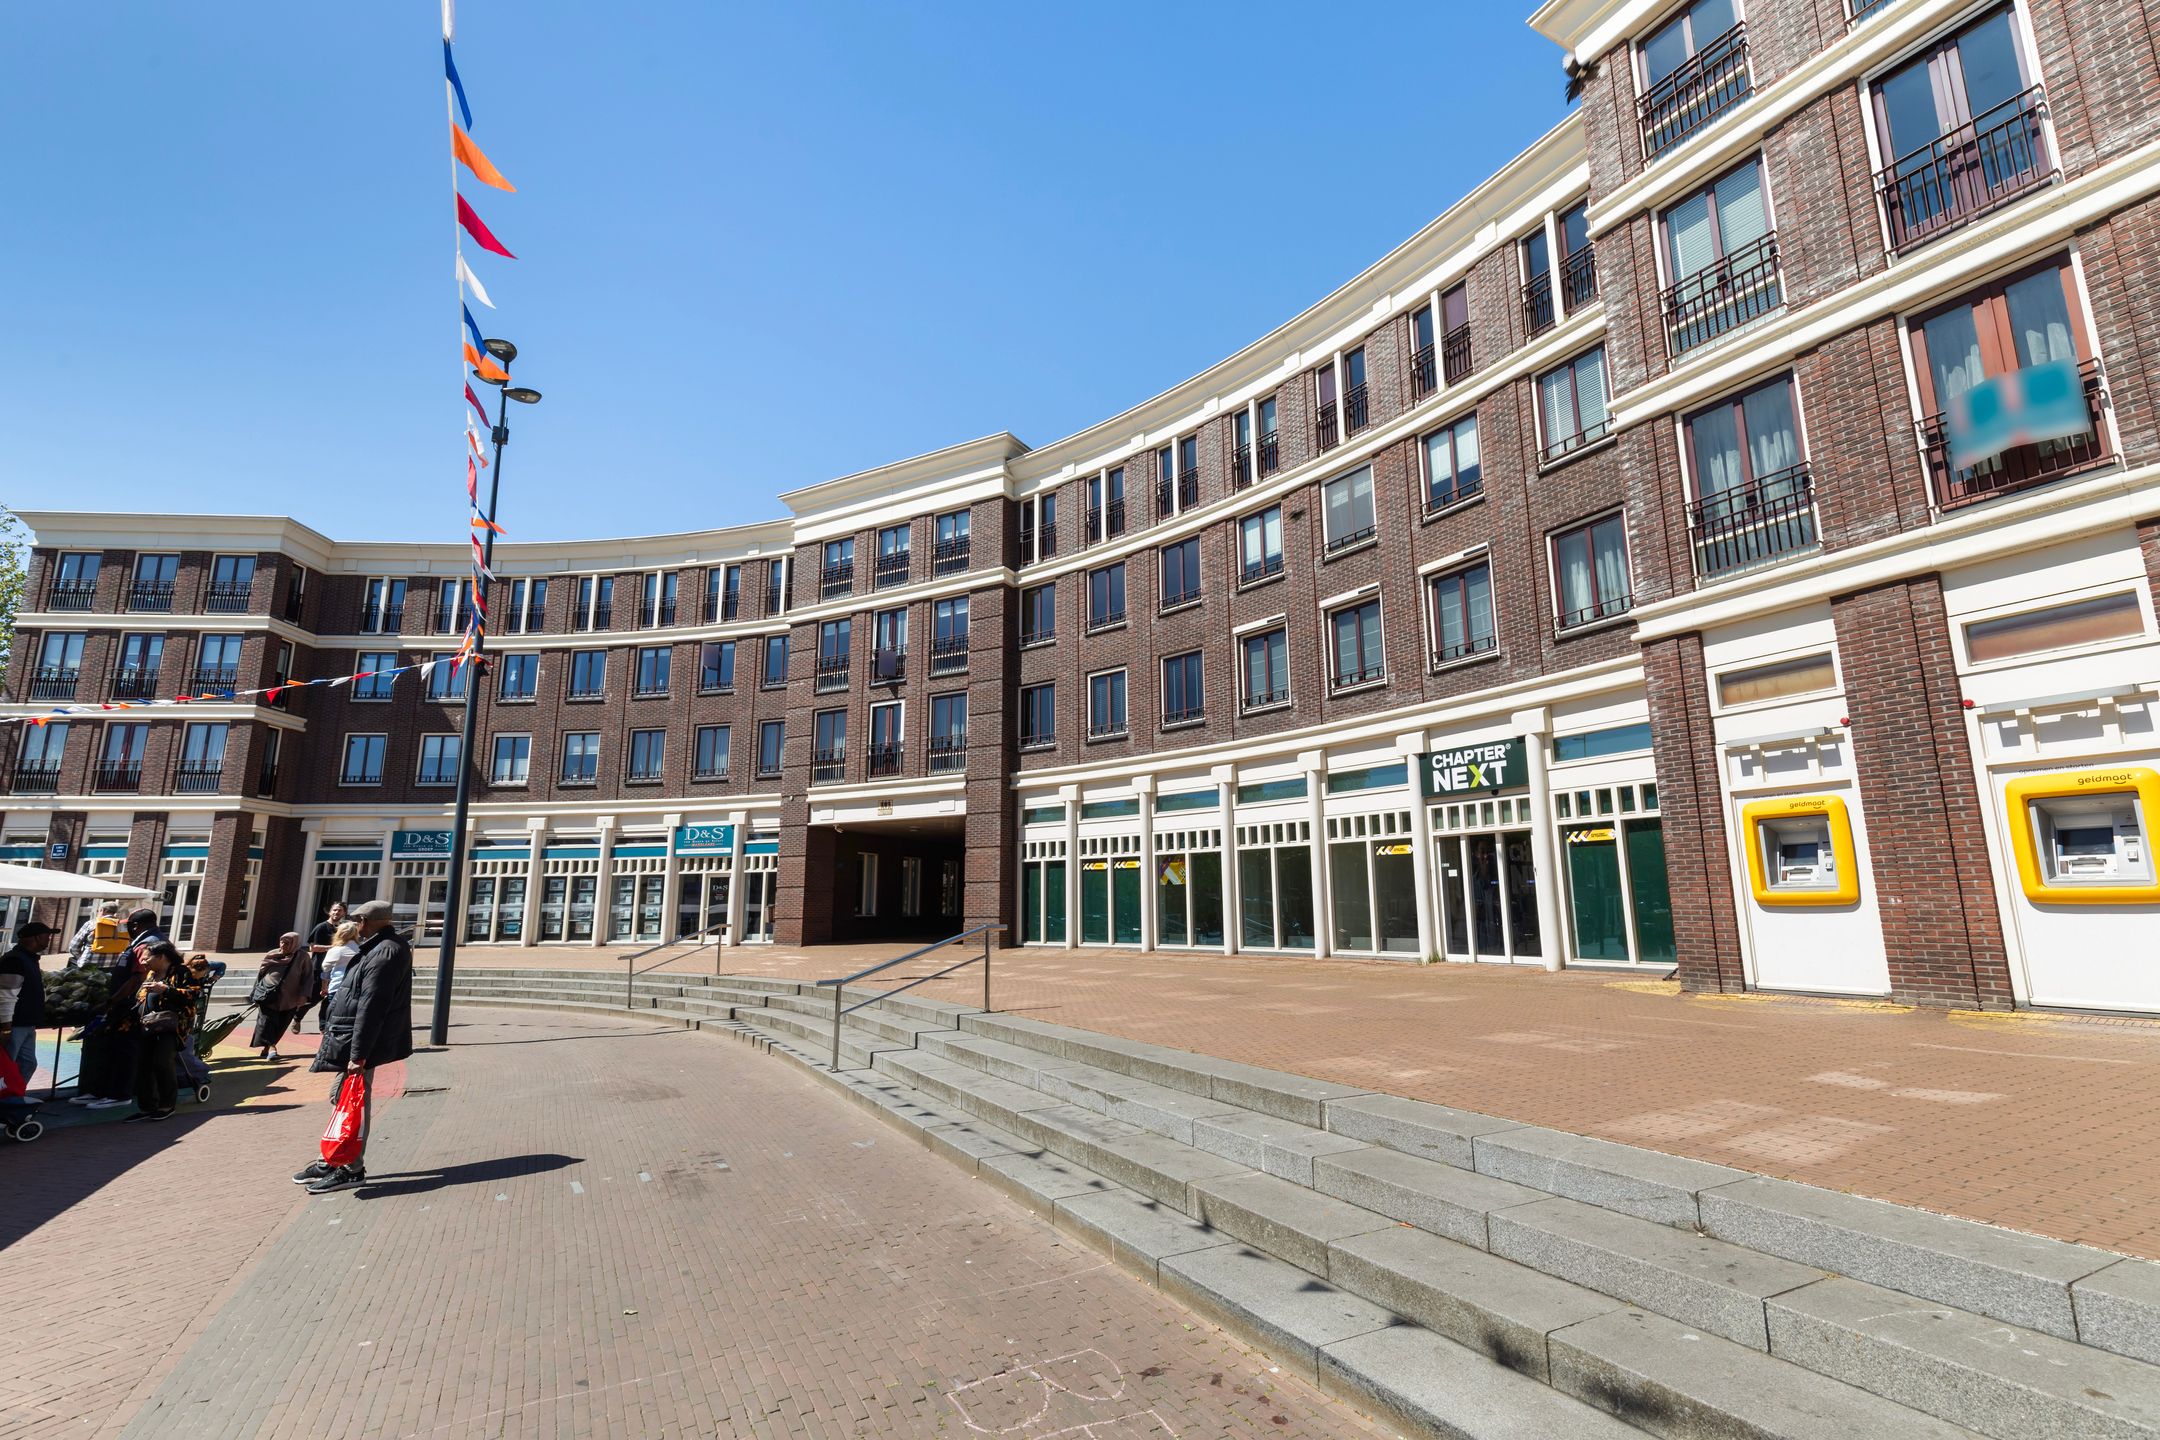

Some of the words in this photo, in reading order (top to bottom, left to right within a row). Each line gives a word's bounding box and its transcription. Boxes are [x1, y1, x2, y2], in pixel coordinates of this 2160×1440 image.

[1432, 760, 1507, 793] NEXT
[2077, 773, 2132, 785] geldmaat
[1789, 800, 1826, 809] geldmaat
[404, 832, 451, 845] D&S
[684, 827, 726, 840] D&S
